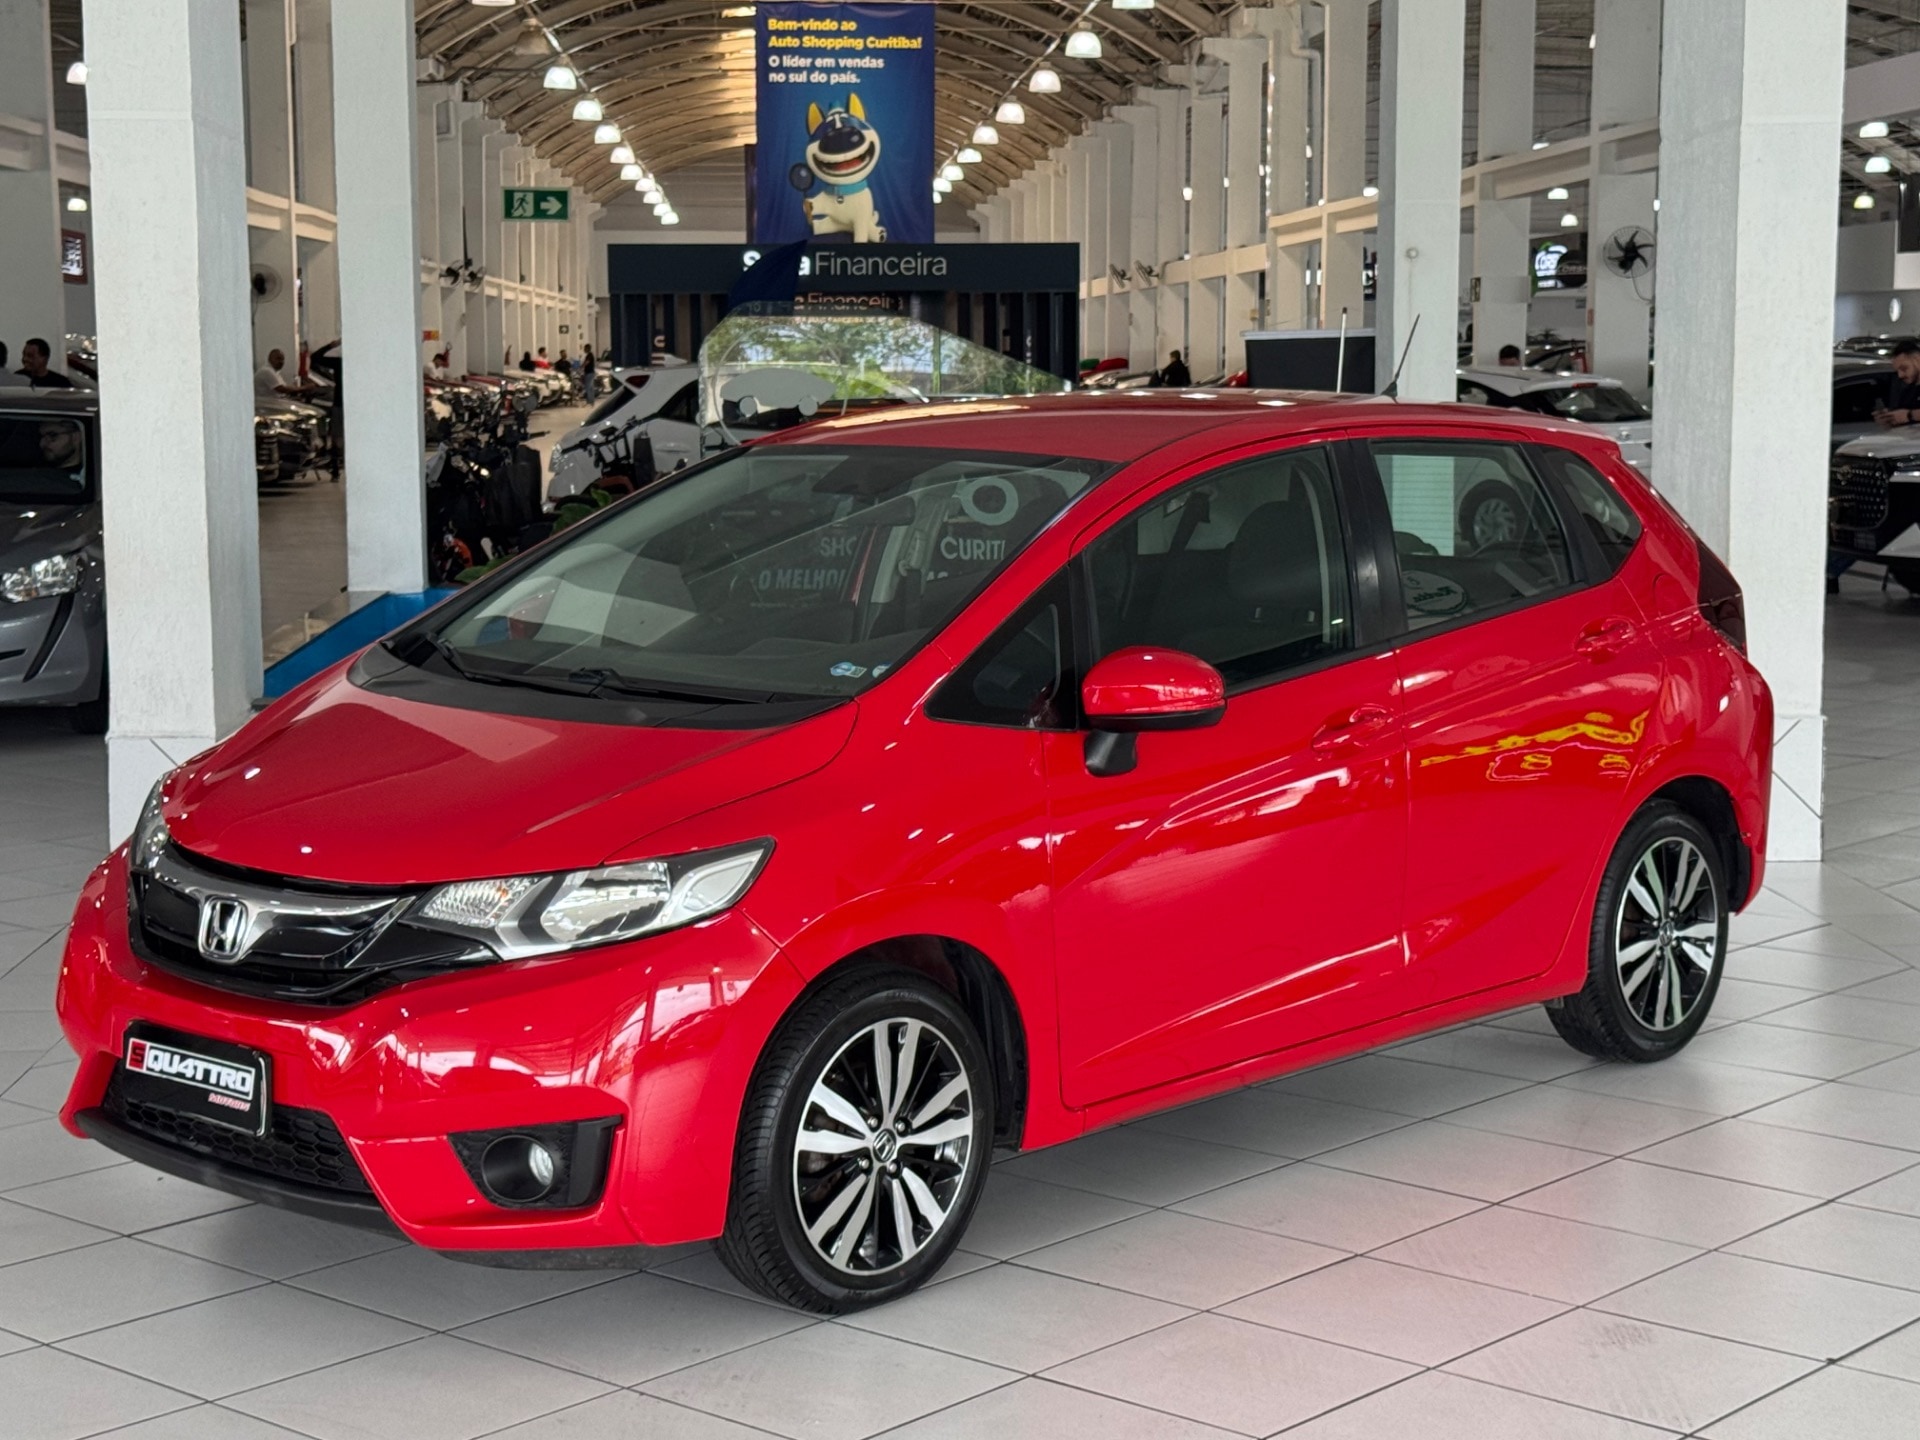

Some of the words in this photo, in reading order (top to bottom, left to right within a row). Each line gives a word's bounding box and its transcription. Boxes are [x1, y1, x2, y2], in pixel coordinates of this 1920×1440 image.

[768, 18, 838, 31] Bem-vindo
[840, 21, 857, 31] ao
[768, 36, 800, 48] Auto
[802, 36, 864, 50] Shopping
[866, 37, 922, 48] Curitiba!
[768, 56, 780, 67] O
[782, 55, 812, 67] líder
[815, 58, 835, 67] em
[839, 56, 884, 68] vendas
[769, 72, 786, 82] no
[789, 71, 806, 83] sul
[810, 71, 827, 83] do
[815, 252, 947, 276] Financeira
